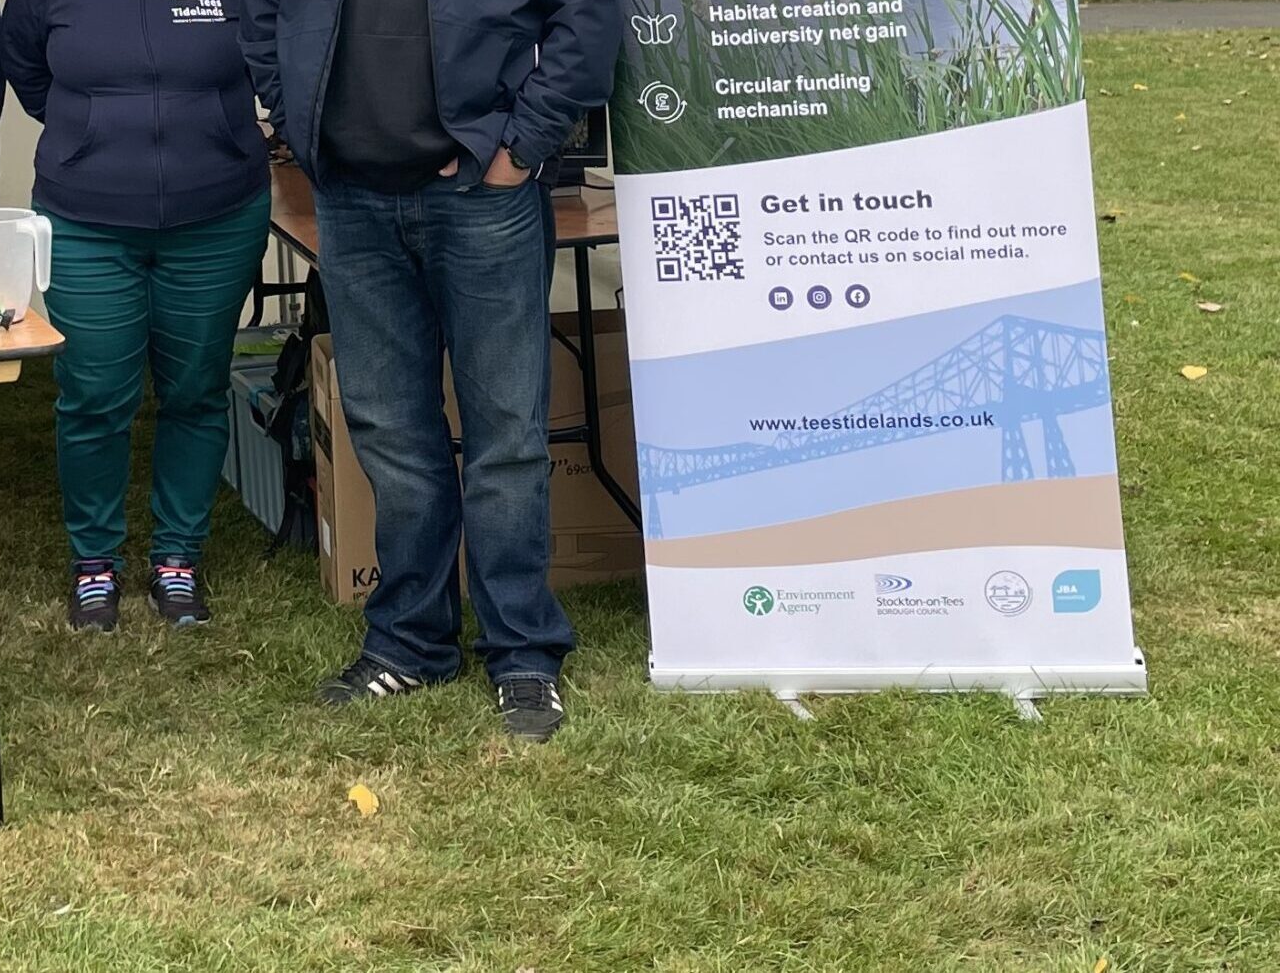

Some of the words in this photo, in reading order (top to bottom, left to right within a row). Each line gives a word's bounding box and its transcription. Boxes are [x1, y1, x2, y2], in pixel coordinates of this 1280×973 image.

[171, 6, 224, 17] Tidelands
[709, 2, 778, 22] Habitat
[782, 0, 862, 19] creation
[710, 26, 824, 47] biodiversity
[829, 23, 861, 41] net
[865, 22, 908, 44] gain
[715, 76, 792, 95] Circular
[796, 73, 872, 93] funding
[718, 101, 828, 120] mechanism
[760, 194, 809, 215] Get
[818, 192, 844, 213] in
[852, 190, 933, 212] touch
[763, 230, 807, 247] Scan
[812, 229, 839, 245] the
[843, 228, 872, 246] QR
[877, 227, 920, 244] code
[925, 227, 942, 242] to
[947, 224, 982, 241] find
[986, 224, 1017, 240] out
[1022, 223, 1068, 237] more
[765, 254, 783, 267] or
[788, 250, 854, 266] contact
[858, 251, 880, 265] us
[884, 249, 908, 264] on
[912, 246, 965, 263] social
[970, 243, 1030, 261] media.
[749, 411, 995, 433] www.teestidelands.co.uk
[352, 567, 381, 588] KA
[776, 589, 855, 602] Environment
[1056, 584, 1078, 594] JBA
[777, 603, 822, 615] Agency
[876, 596, 965, 608] Stockton-on-Tees
[877, 607, 915, 616] BOROUGH
[916, 606, 950, 615] COUNCIL
